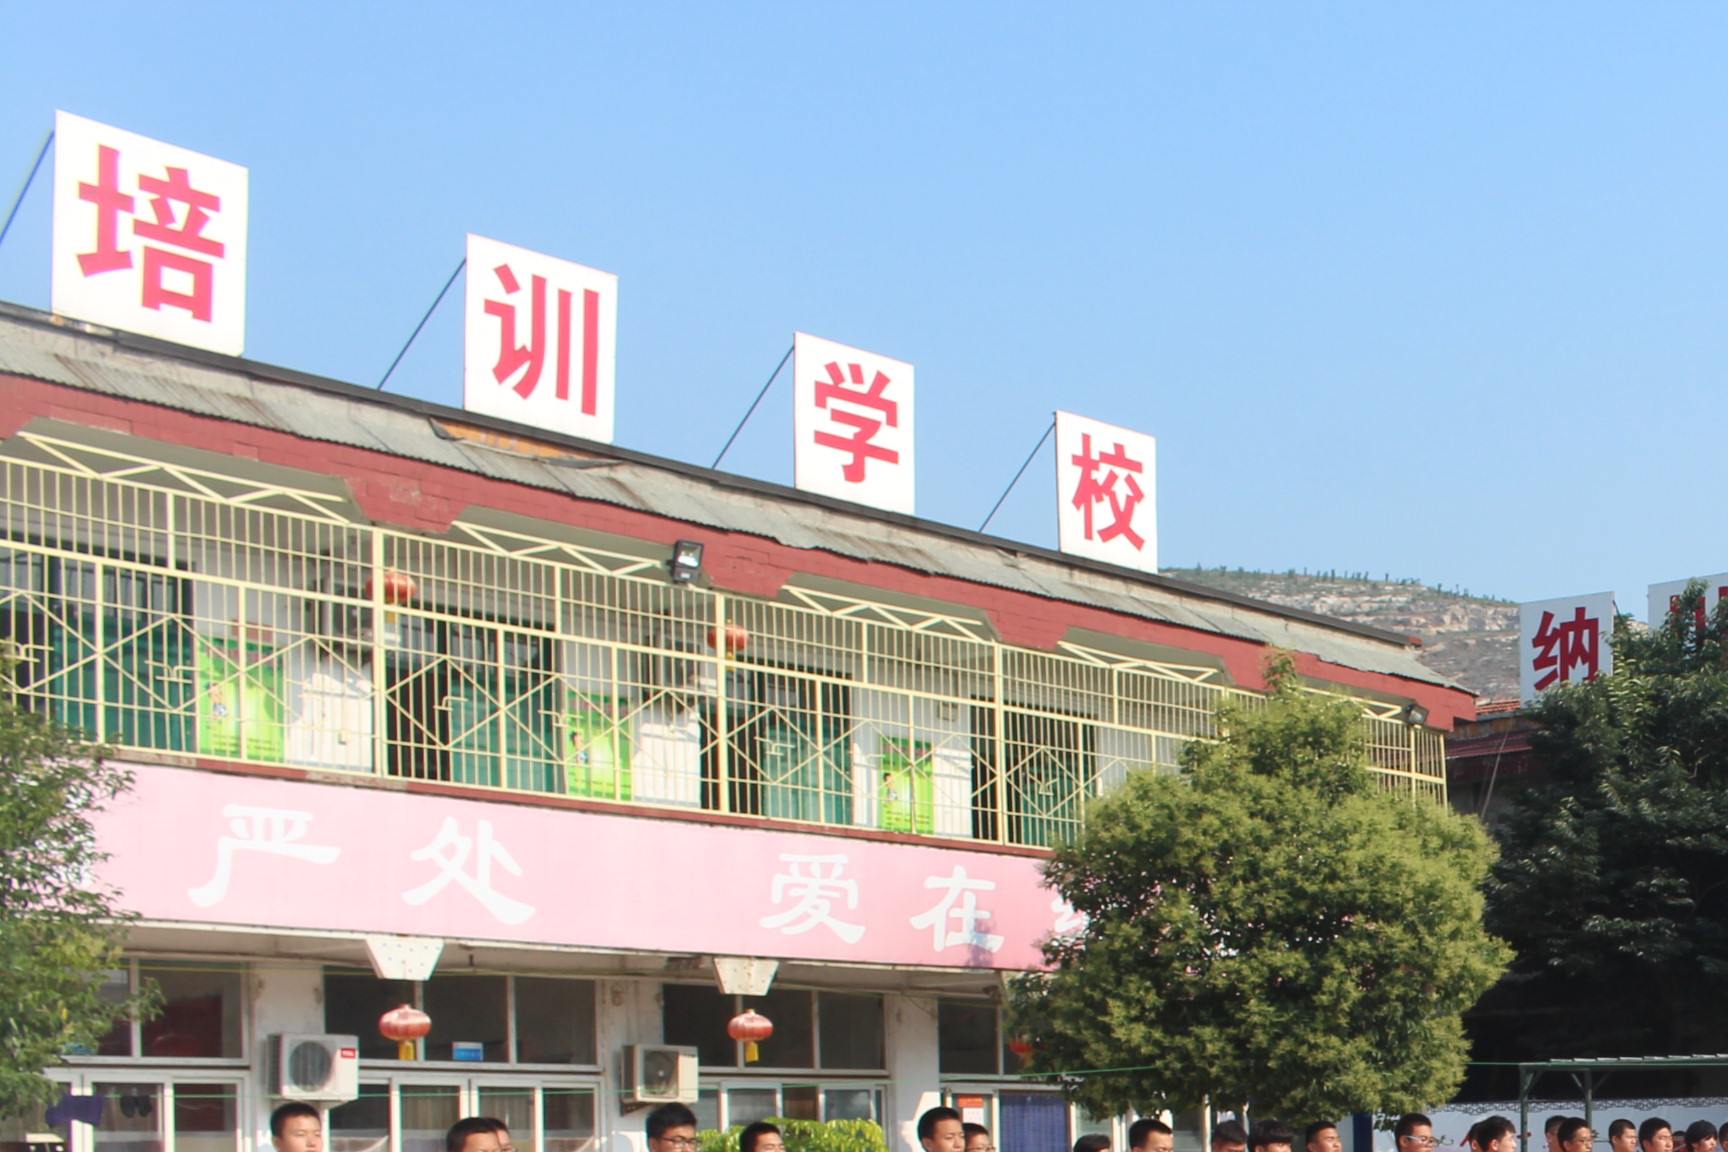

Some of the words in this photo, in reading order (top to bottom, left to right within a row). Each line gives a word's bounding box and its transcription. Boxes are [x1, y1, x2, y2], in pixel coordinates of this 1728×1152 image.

[77, 144, 1146, 551] 培训学校
[189, 804, 536, 925] 严处
